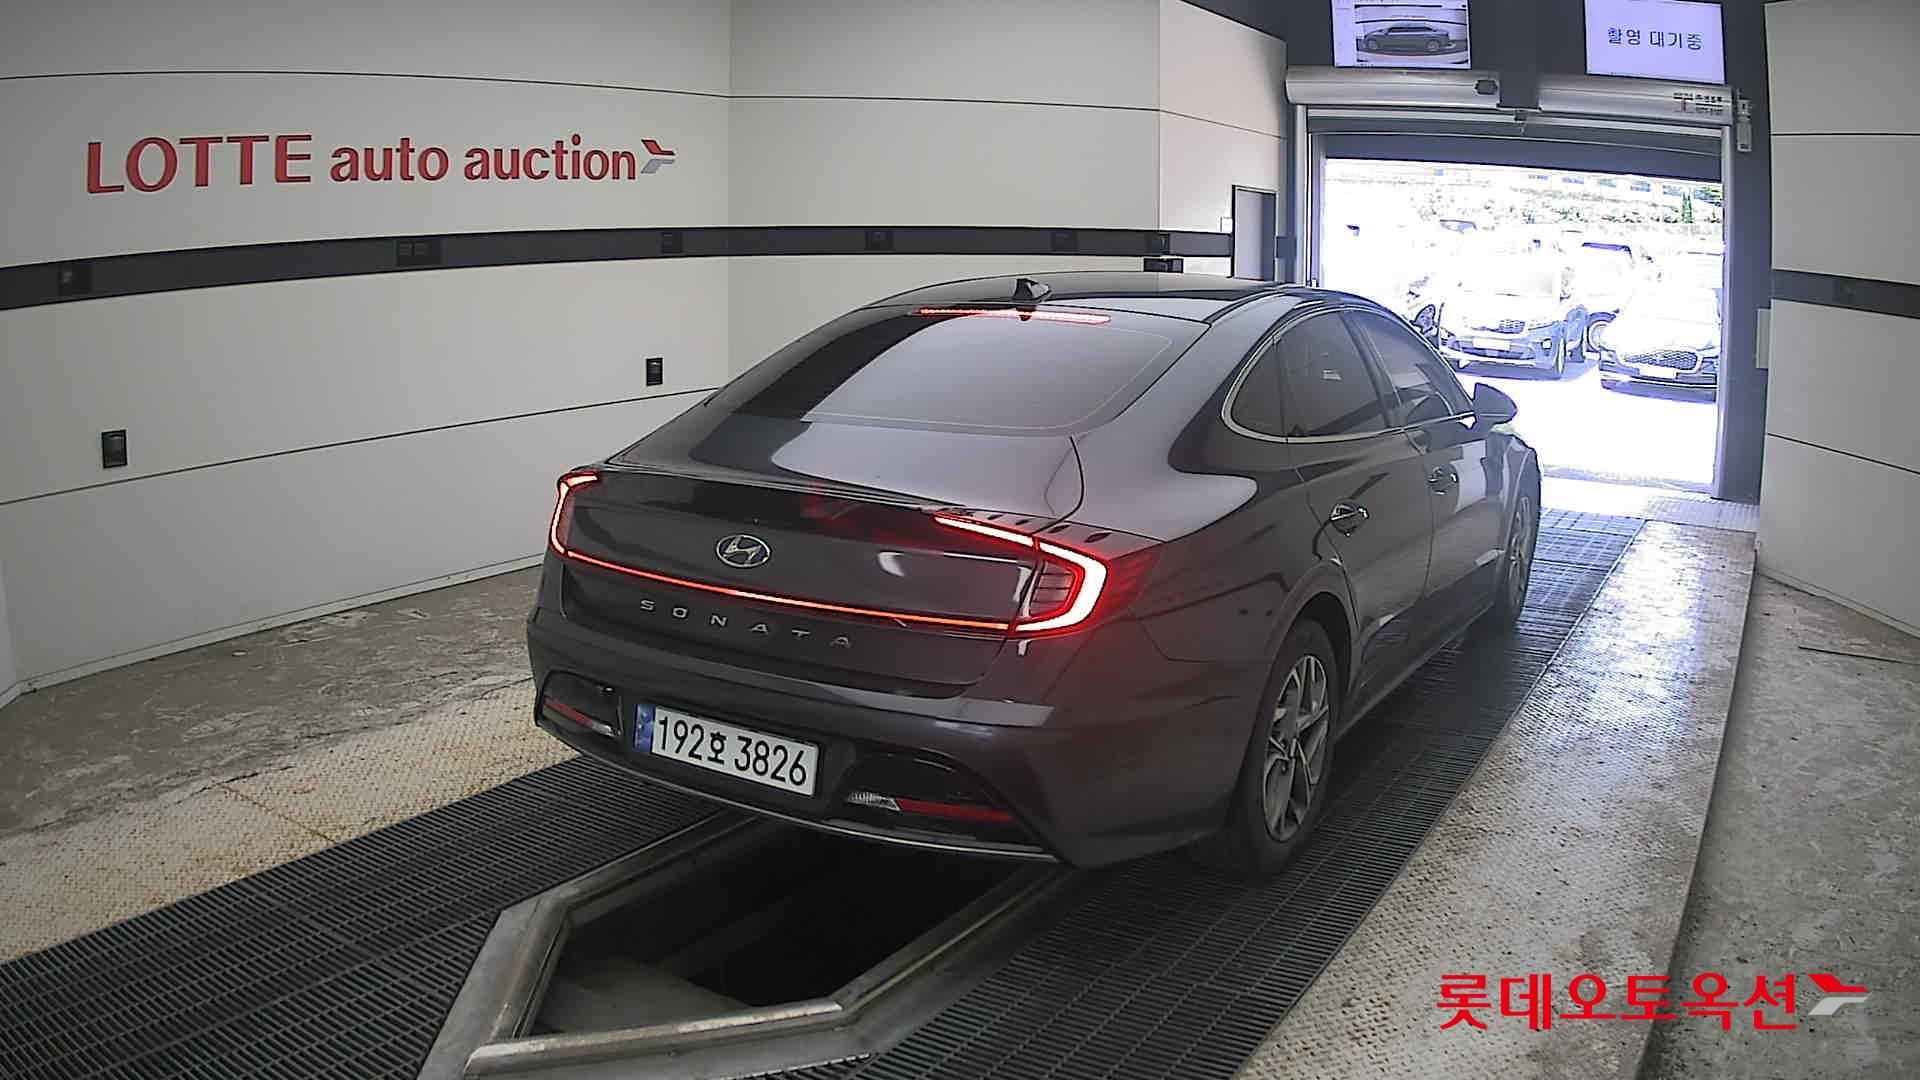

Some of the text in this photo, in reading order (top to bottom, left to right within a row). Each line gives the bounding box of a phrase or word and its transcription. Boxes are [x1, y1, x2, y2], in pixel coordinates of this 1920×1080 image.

[1649, 30, 1702, 51] 대기중
[87, 134, 637, 193] LOTTE auto auction
[640, 599, 850, 647] SONATA
[658, 716, 807, 786] 192호 3826
